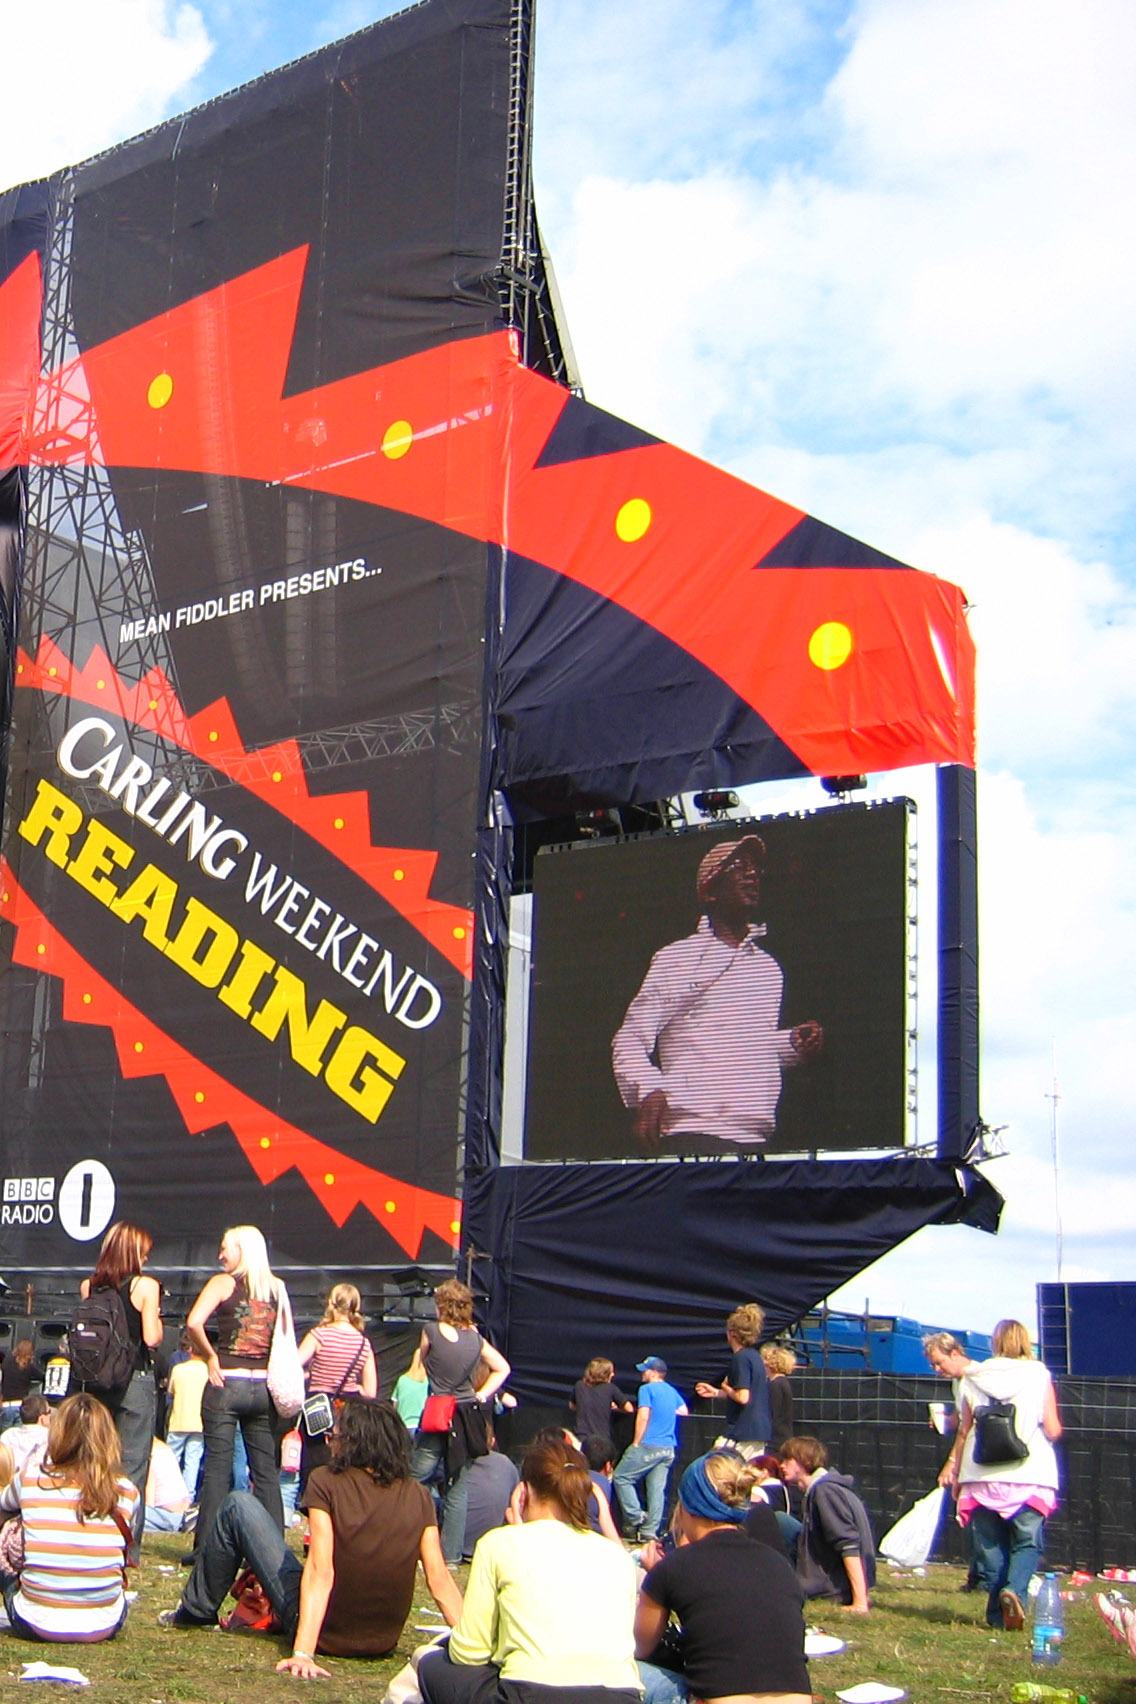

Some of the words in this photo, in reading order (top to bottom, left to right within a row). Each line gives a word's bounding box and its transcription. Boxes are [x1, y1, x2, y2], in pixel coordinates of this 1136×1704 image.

[119, 612, 171, 644] MEAN
[175, 589, 255, 629] FIDDLER
[260, 558, 383, 606] PRESENTS...
[58, 716, 249, 880] CARLING
[245, 851, 441, 1029] WEEKEND
[18, 778, 406, 1125] READING
[1, 1204, 54, 1225] RADIO
[6, 1179, 54, 1201] BBC
